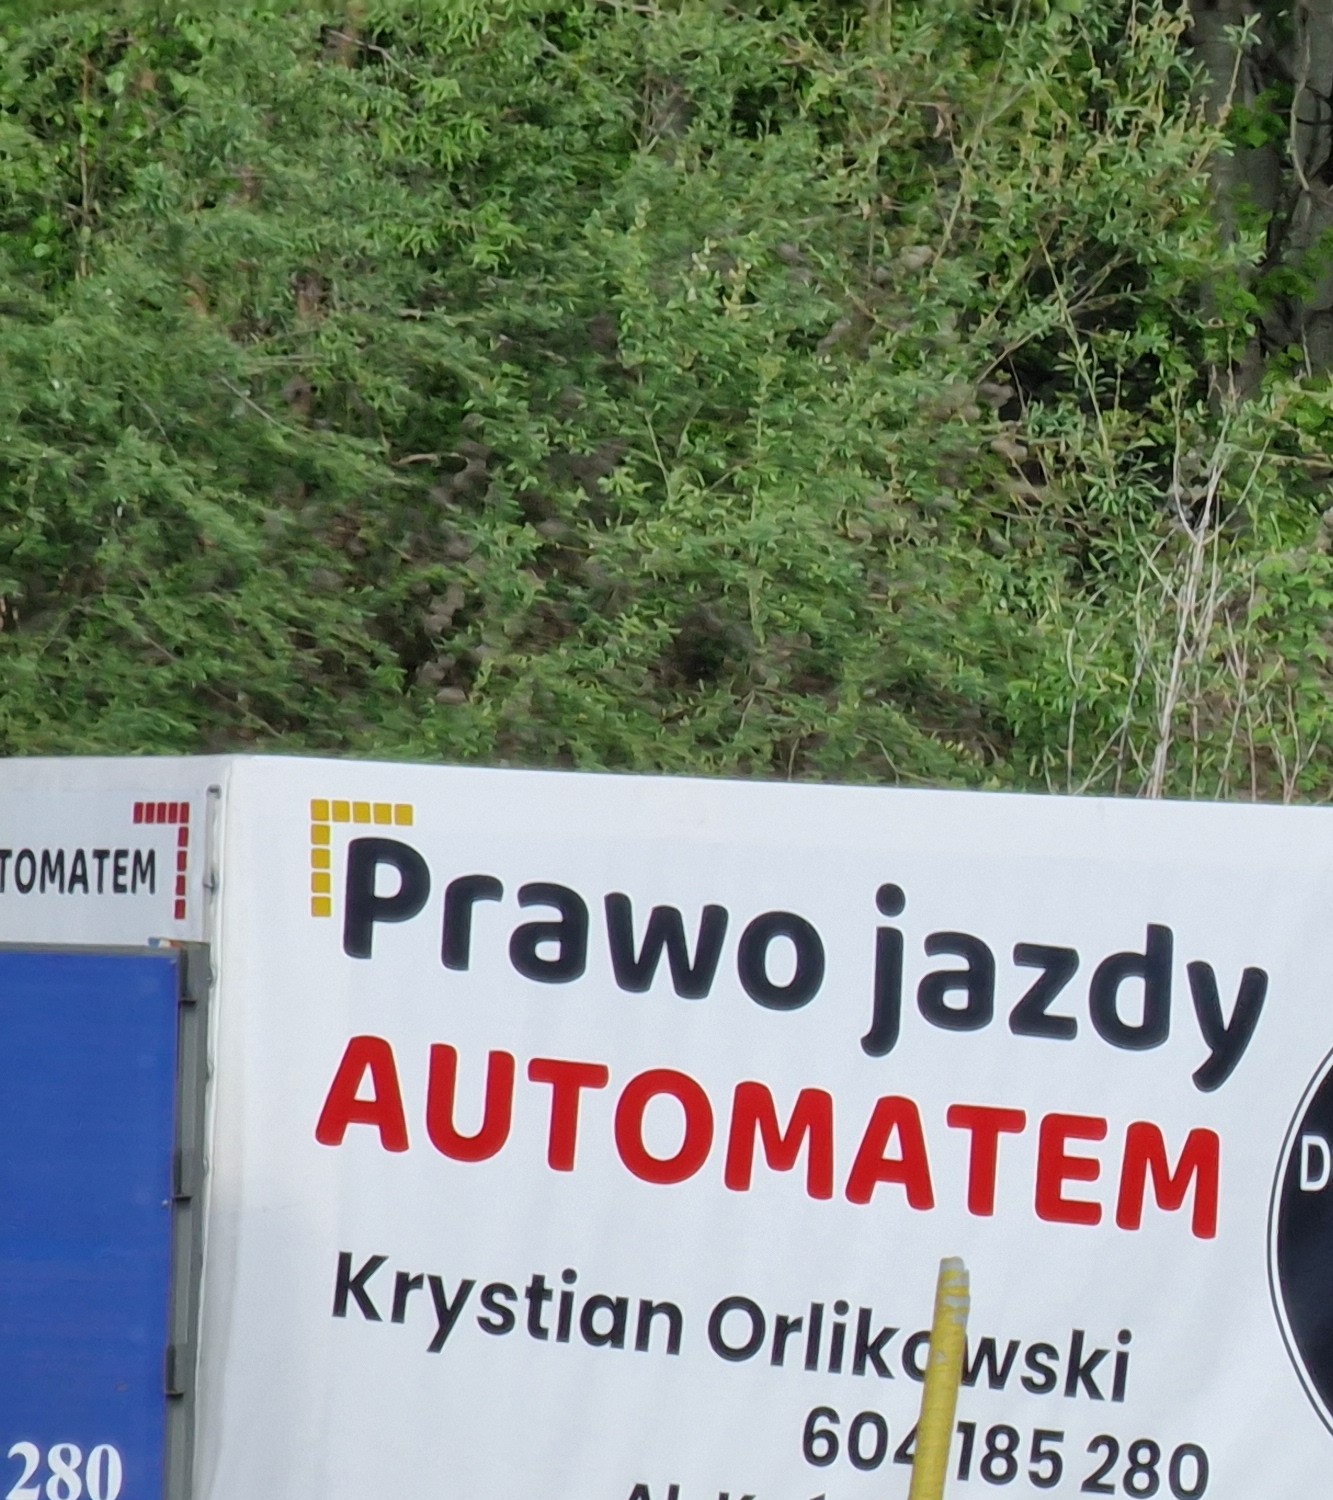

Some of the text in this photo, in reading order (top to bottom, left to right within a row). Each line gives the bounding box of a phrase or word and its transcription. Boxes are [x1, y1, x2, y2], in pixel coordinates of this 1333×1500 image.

[342, 836, 1269, 1093] Prawo jazdy
[315, 1034, 1220, 1240] AUTOMATEM
[332, 1250, 684, 1355] Krystian
[956, 1420, 1065, 1490] 185
